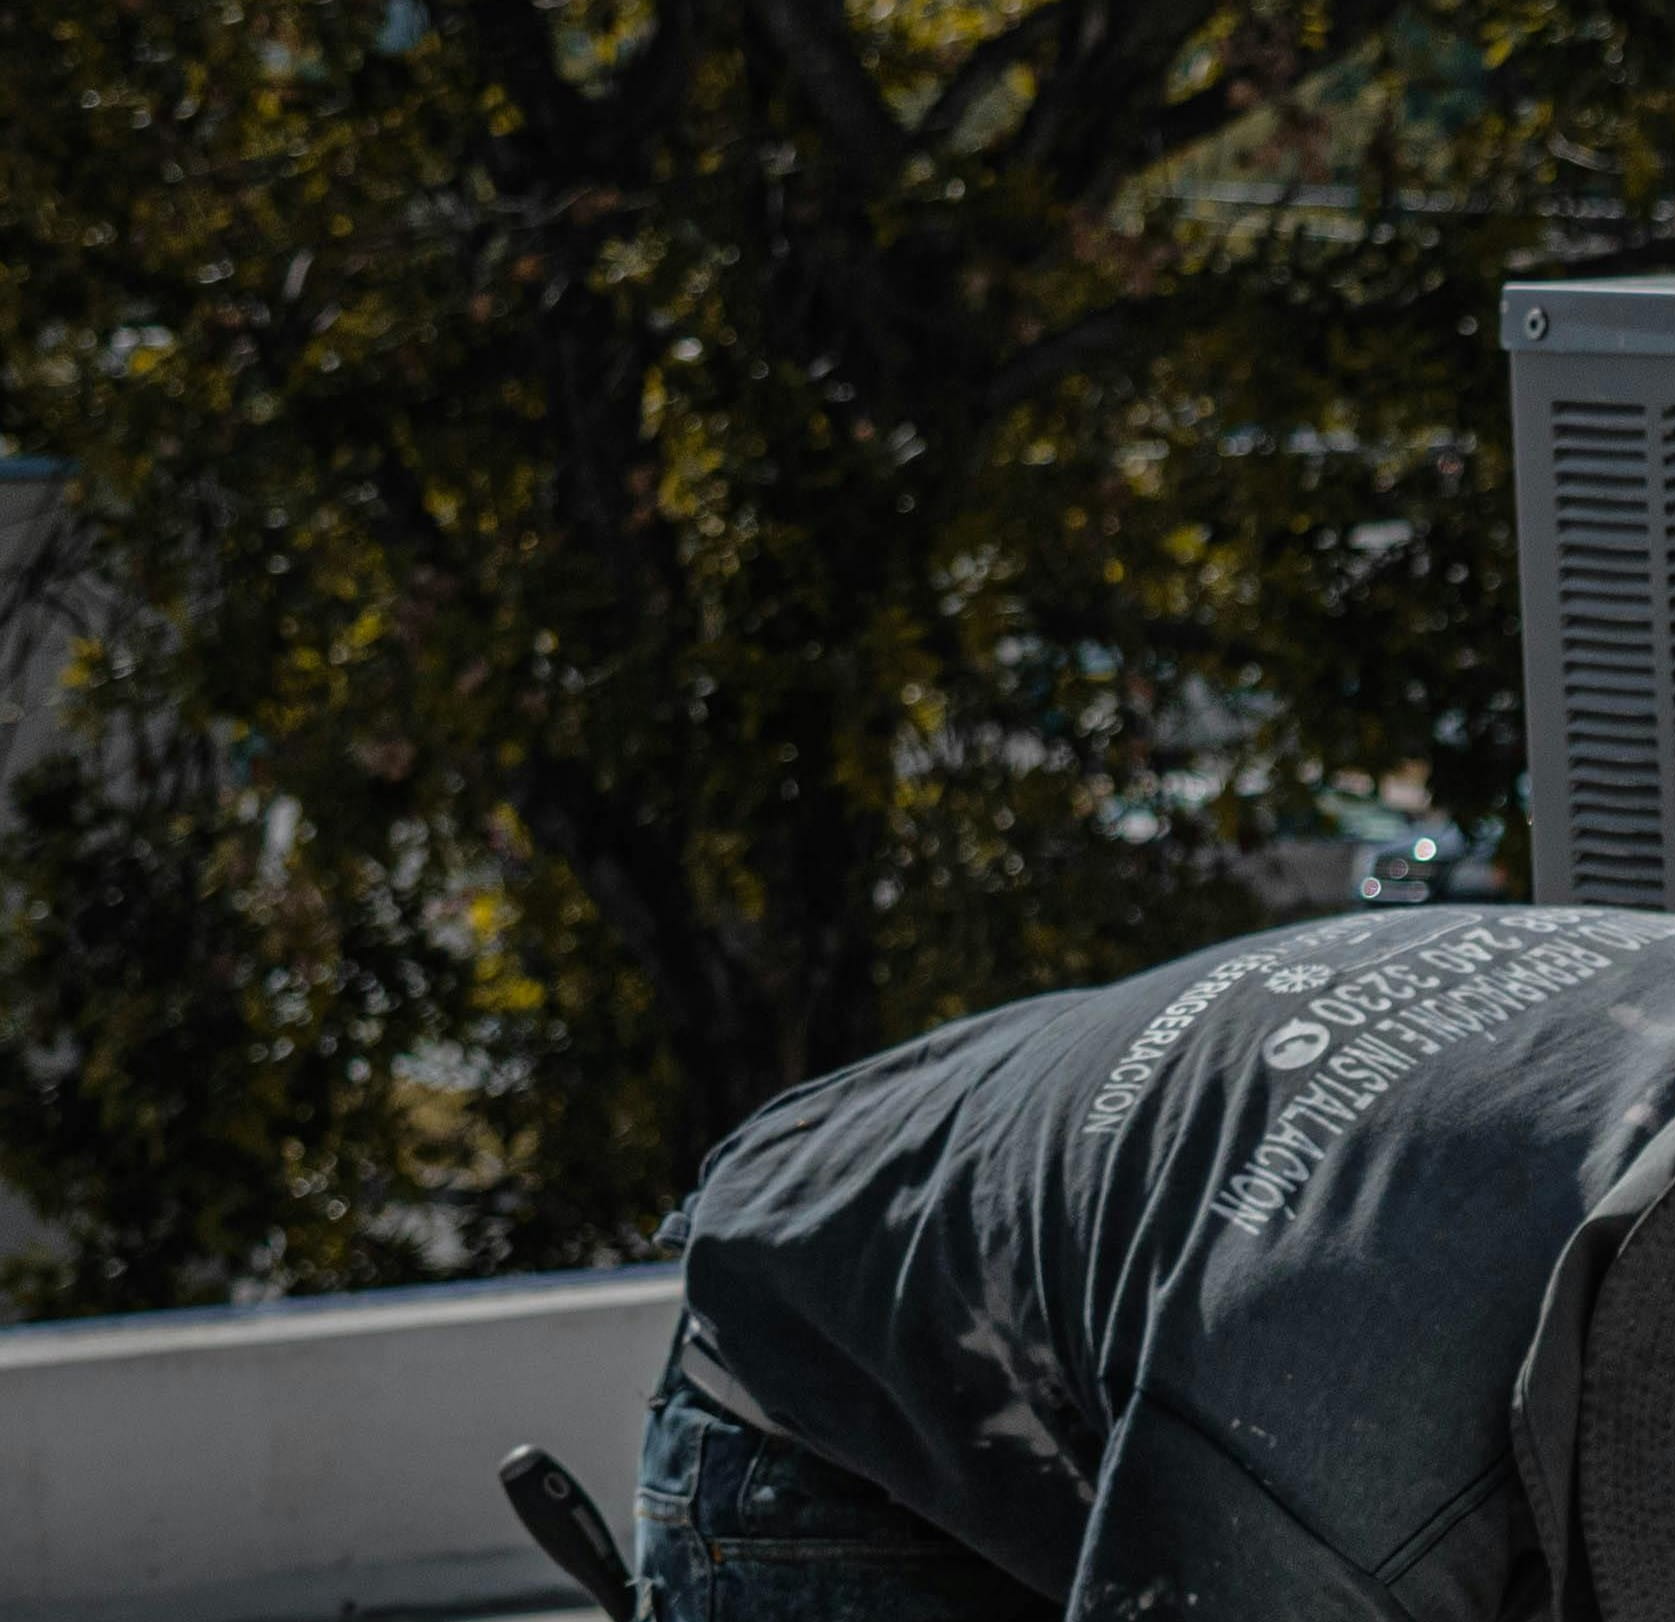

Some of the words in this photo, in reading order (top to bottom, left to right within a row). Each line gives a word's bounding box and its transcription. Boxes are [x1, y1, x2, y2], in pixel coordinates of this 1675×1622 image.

[1418, 927, 1524, 975] 240
[1308, 964, 1441, 1026] 3230
[1398, 936, 1612, 1043] REPARACIÓN
[1375, 1017, 1442, 1053] E
[1208, 1032, 1418, 1235] INSTALACIÓN
